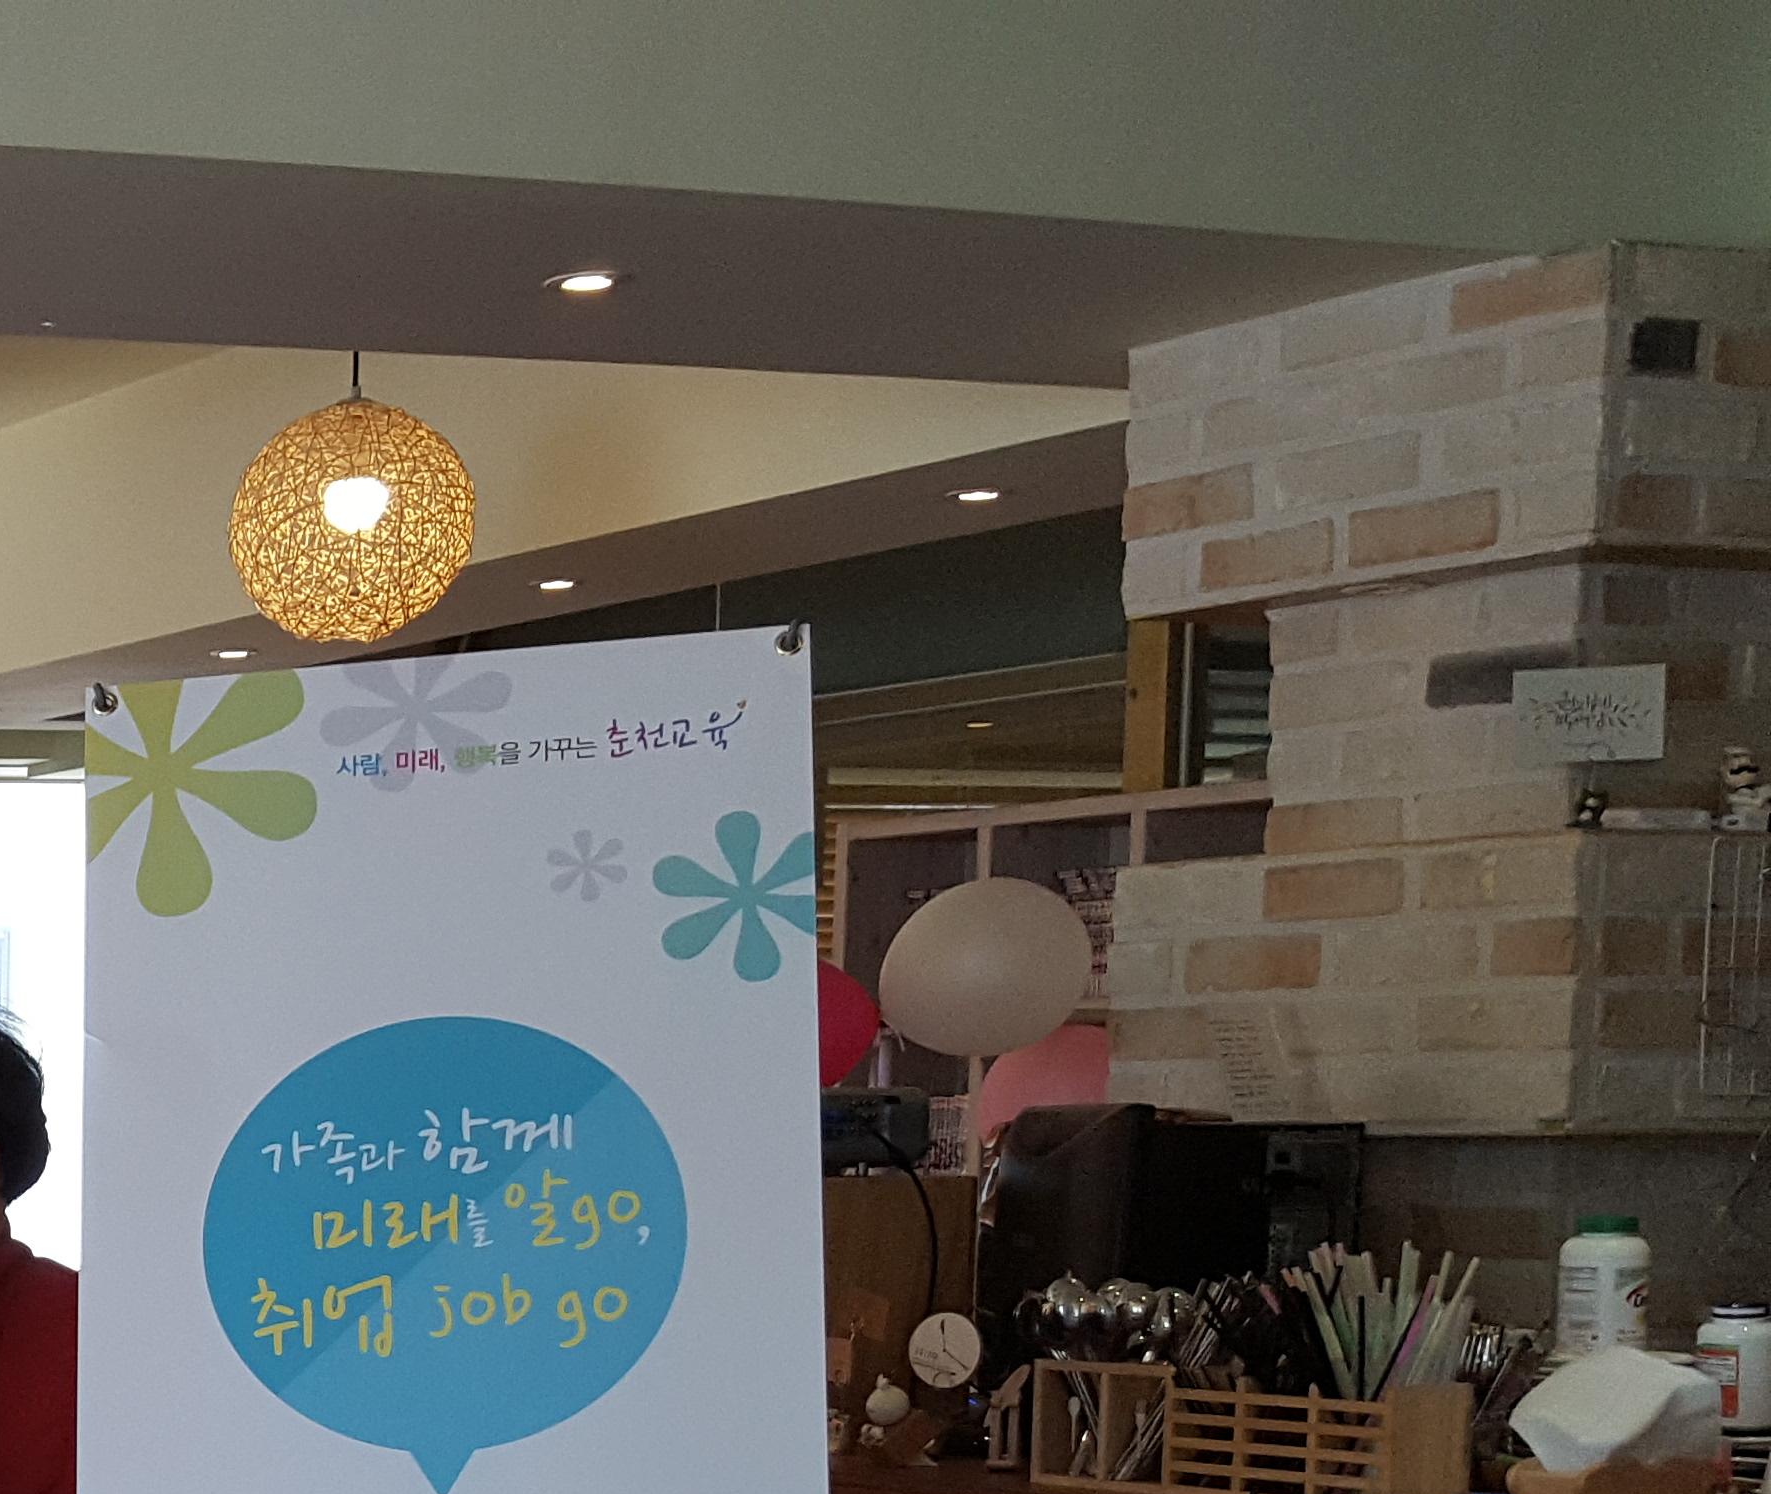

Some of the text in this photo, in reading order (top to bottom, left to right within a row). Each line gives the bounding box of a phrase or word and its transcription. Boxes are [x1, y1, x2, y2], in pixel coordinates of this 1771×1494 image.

[336, 700, 749, 779] 사람, 미래, 행복을 가꾸는 춘천교육
[261, 1107, 576, 1185] 가족과 함께
[313, 1169, 651, 1251] 미래를 알go,
[250, 1273, 630, 1357] 취업 job go
